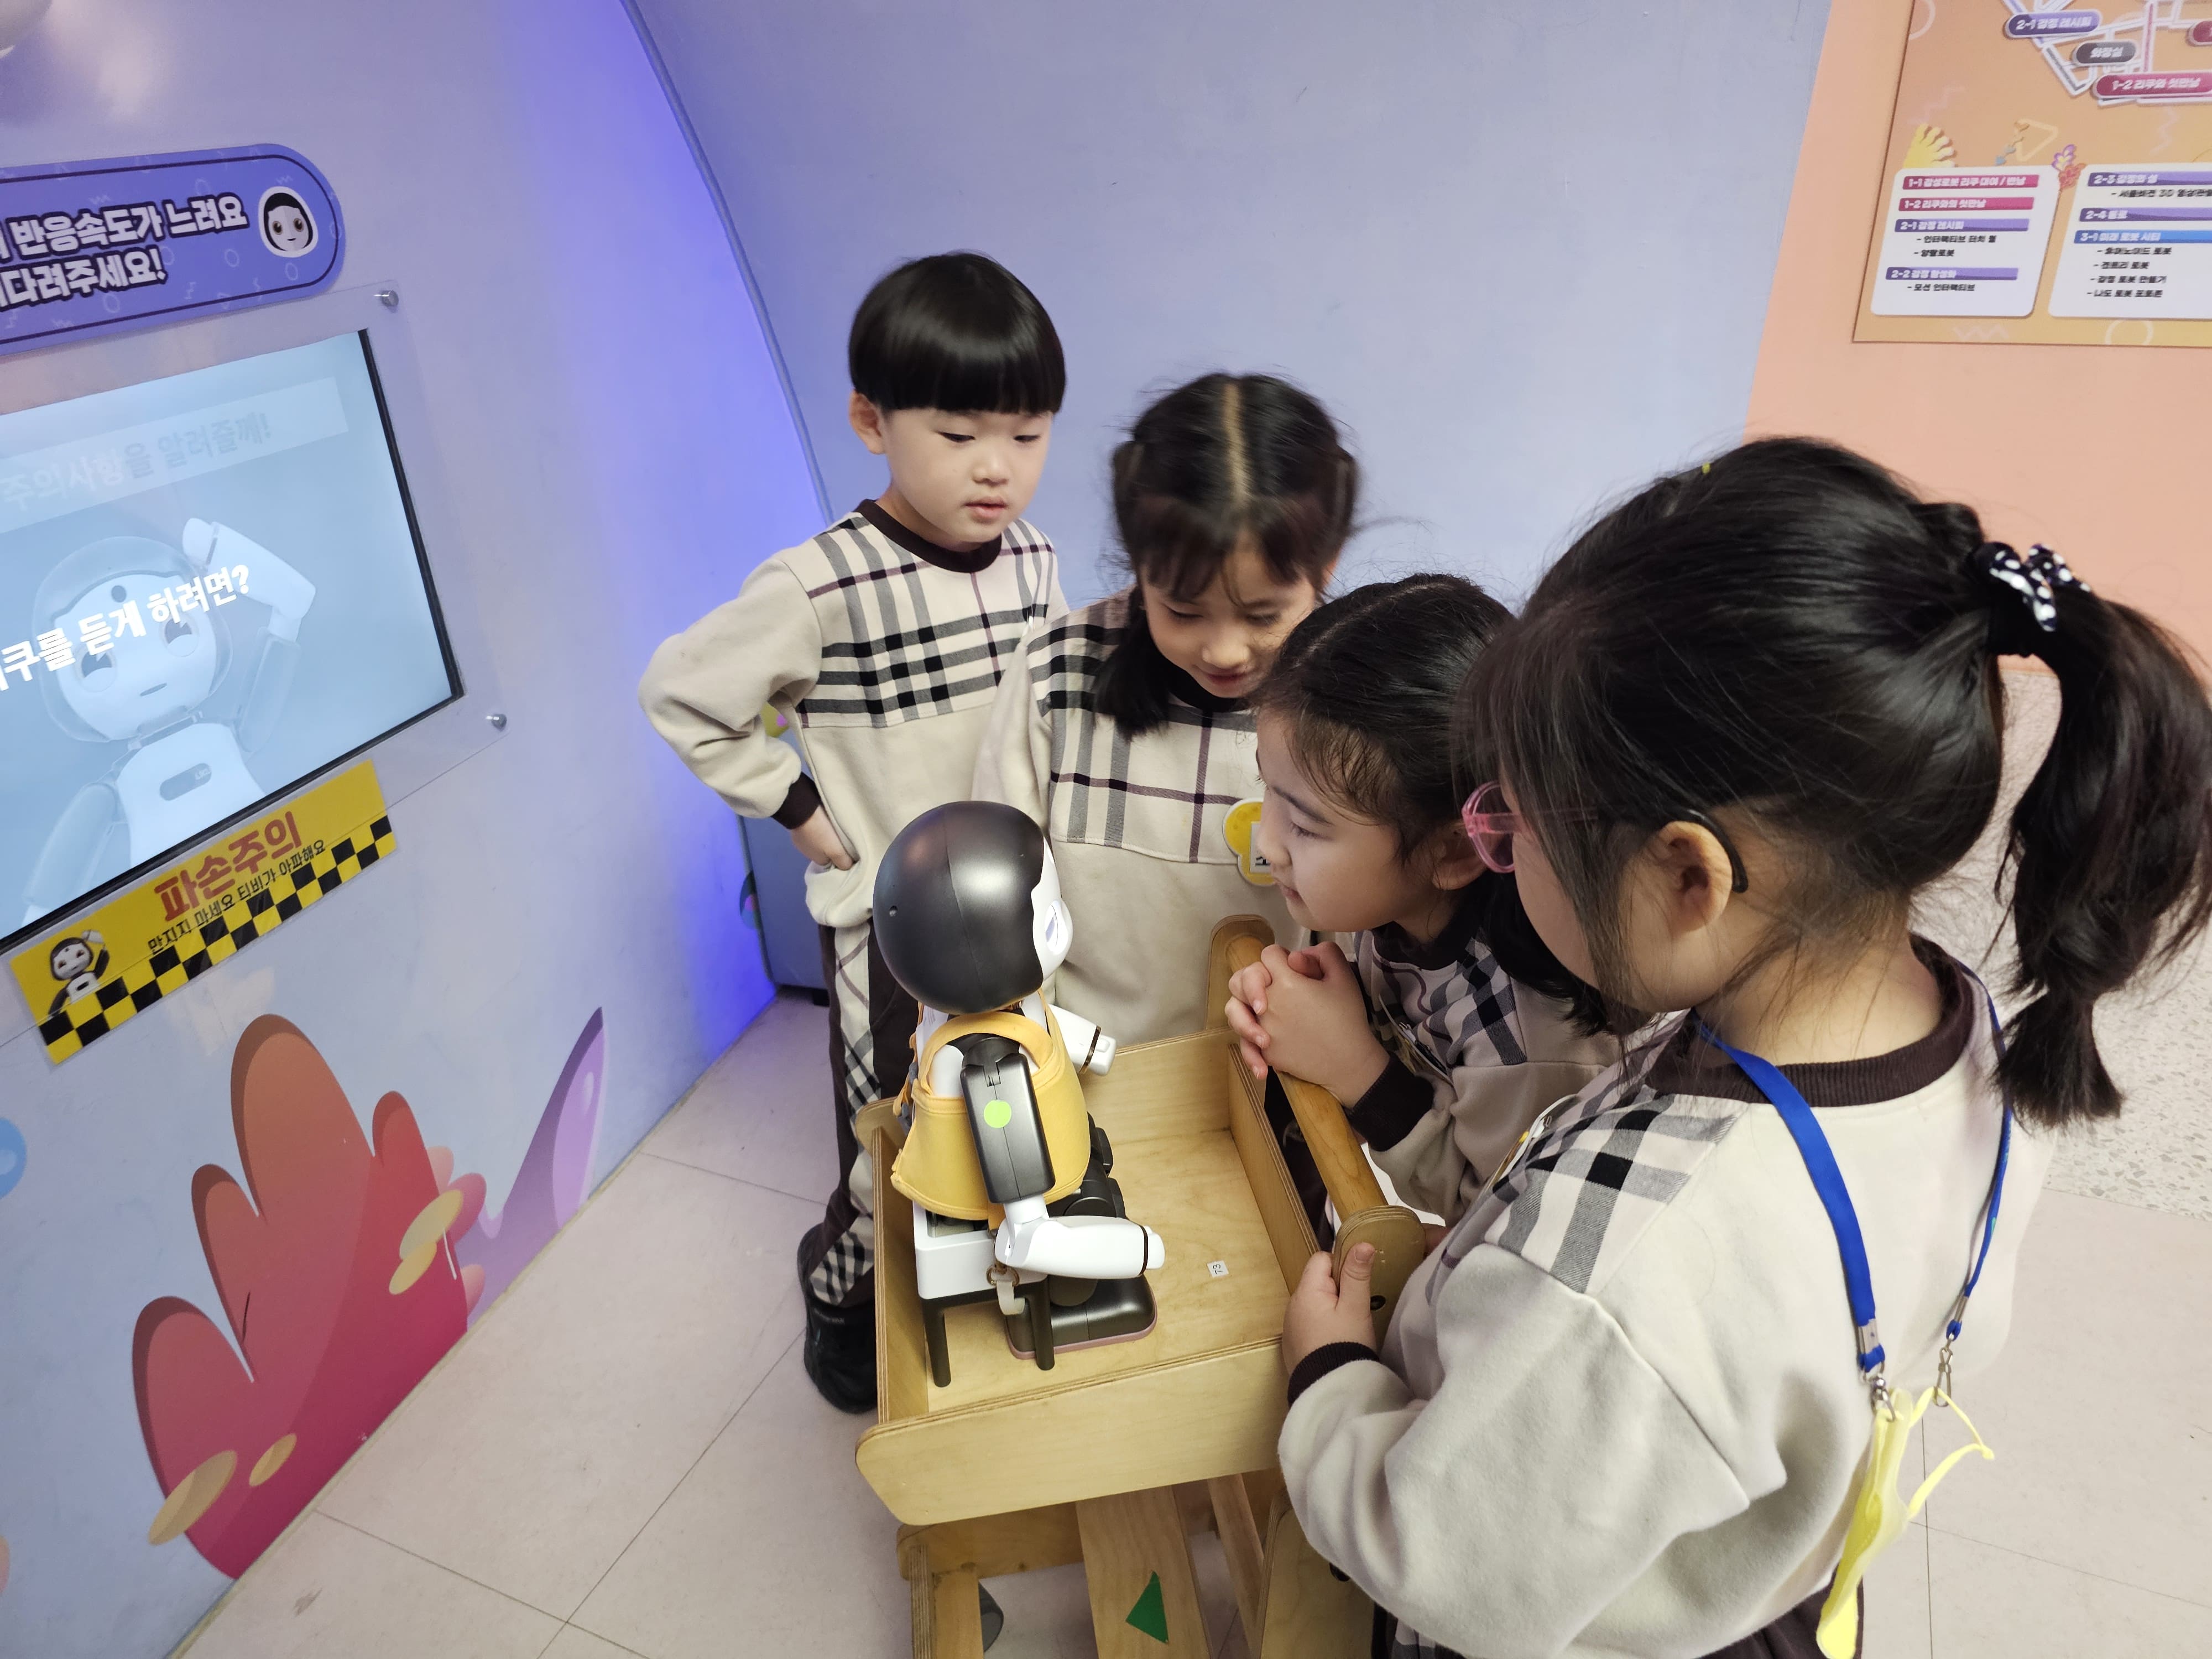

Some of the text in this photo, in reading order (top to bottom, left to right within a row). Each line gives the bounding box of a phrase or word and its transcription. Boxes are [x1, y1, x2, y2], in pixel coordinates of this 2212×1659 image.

[2090, 46, 2124, 58] 화장실
[9, 205, 163, 255] 반응속도가
[165, 196, 248, 234] 느려요
[78, 600, 146, 656] 듣게
[147, 564, 249, 624] 하려면?
[148, 839, 325, 954] 만지지 마세요 티비가 아파해요
[154, 811, 302, 921] 파손주의
[1213, 1264, 1223, 1274] 73
